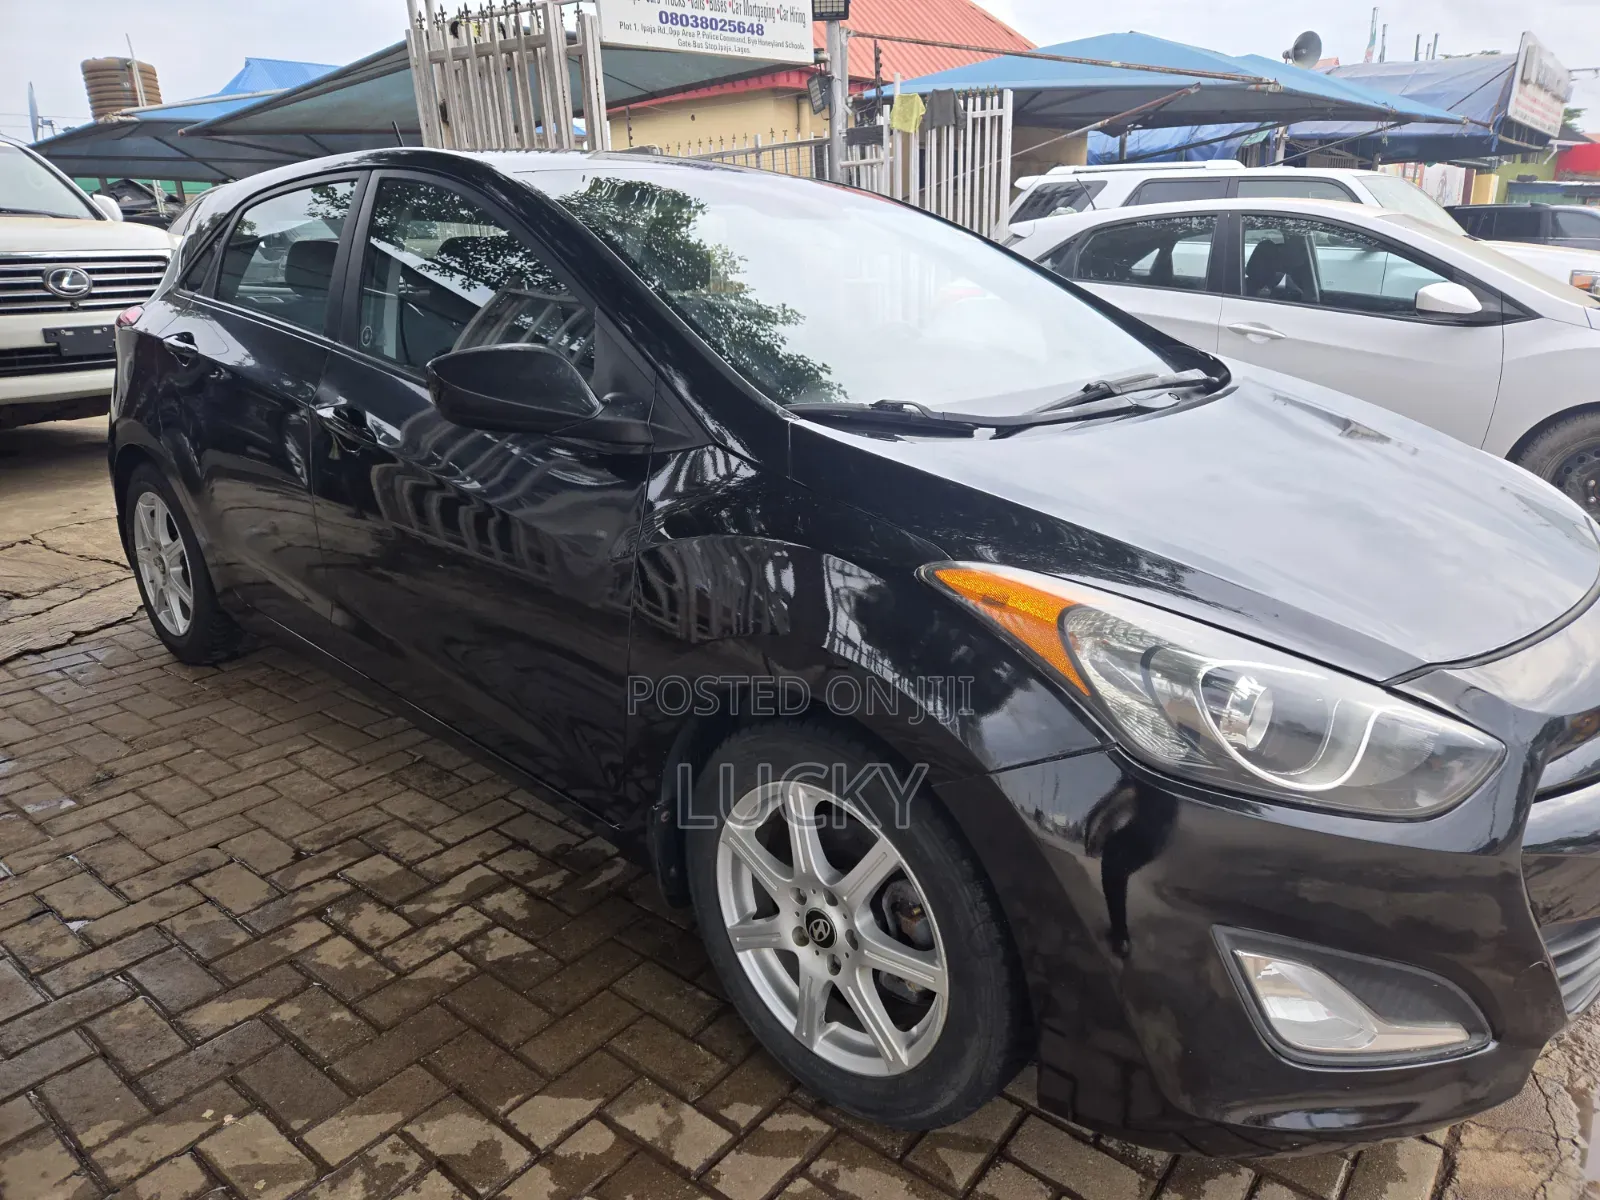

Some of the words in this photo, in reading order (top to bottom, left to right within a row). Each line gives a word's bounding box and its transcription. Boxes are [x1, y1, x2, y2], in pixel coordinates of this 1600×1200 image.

[658, 10, 765, 36] 08038025648
[743, 0, 776, 23] Mortgaging
[789, 6, 806, 28] Hiring
[619, 21, 632, 31] Plot
[682, 28, 695, 38] Area
[678, 38, 691, 48] Gate
[692, 40, 704, 49] Bus
